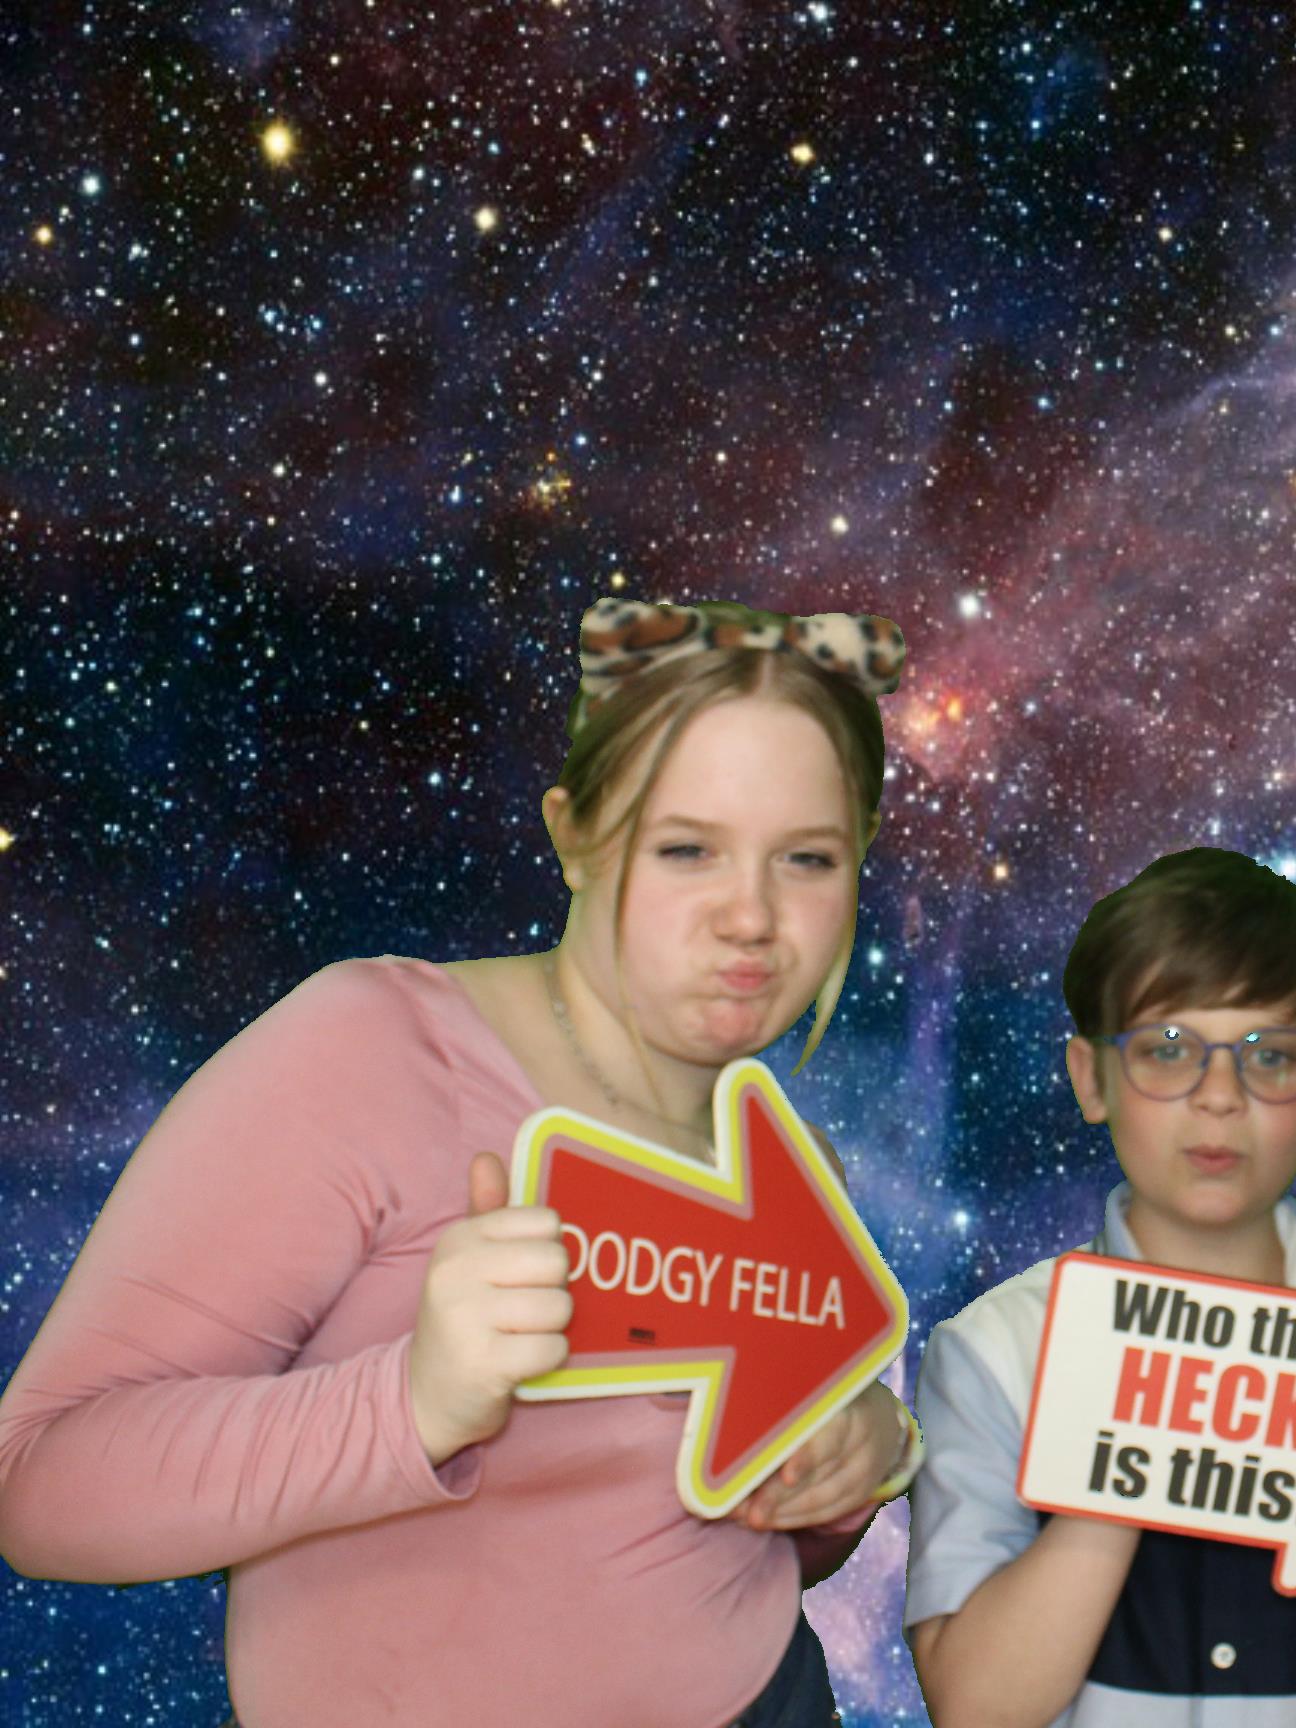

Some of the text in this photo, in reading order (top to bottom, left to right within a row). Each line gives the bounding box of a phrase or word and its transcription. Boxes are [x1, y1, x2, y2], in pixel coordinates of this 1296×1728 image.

[729, 1257, 845, 1330] FELLA
[1112, 1279, 1235, 1346] Who
[1087, 1431, 1151, 1498] is
